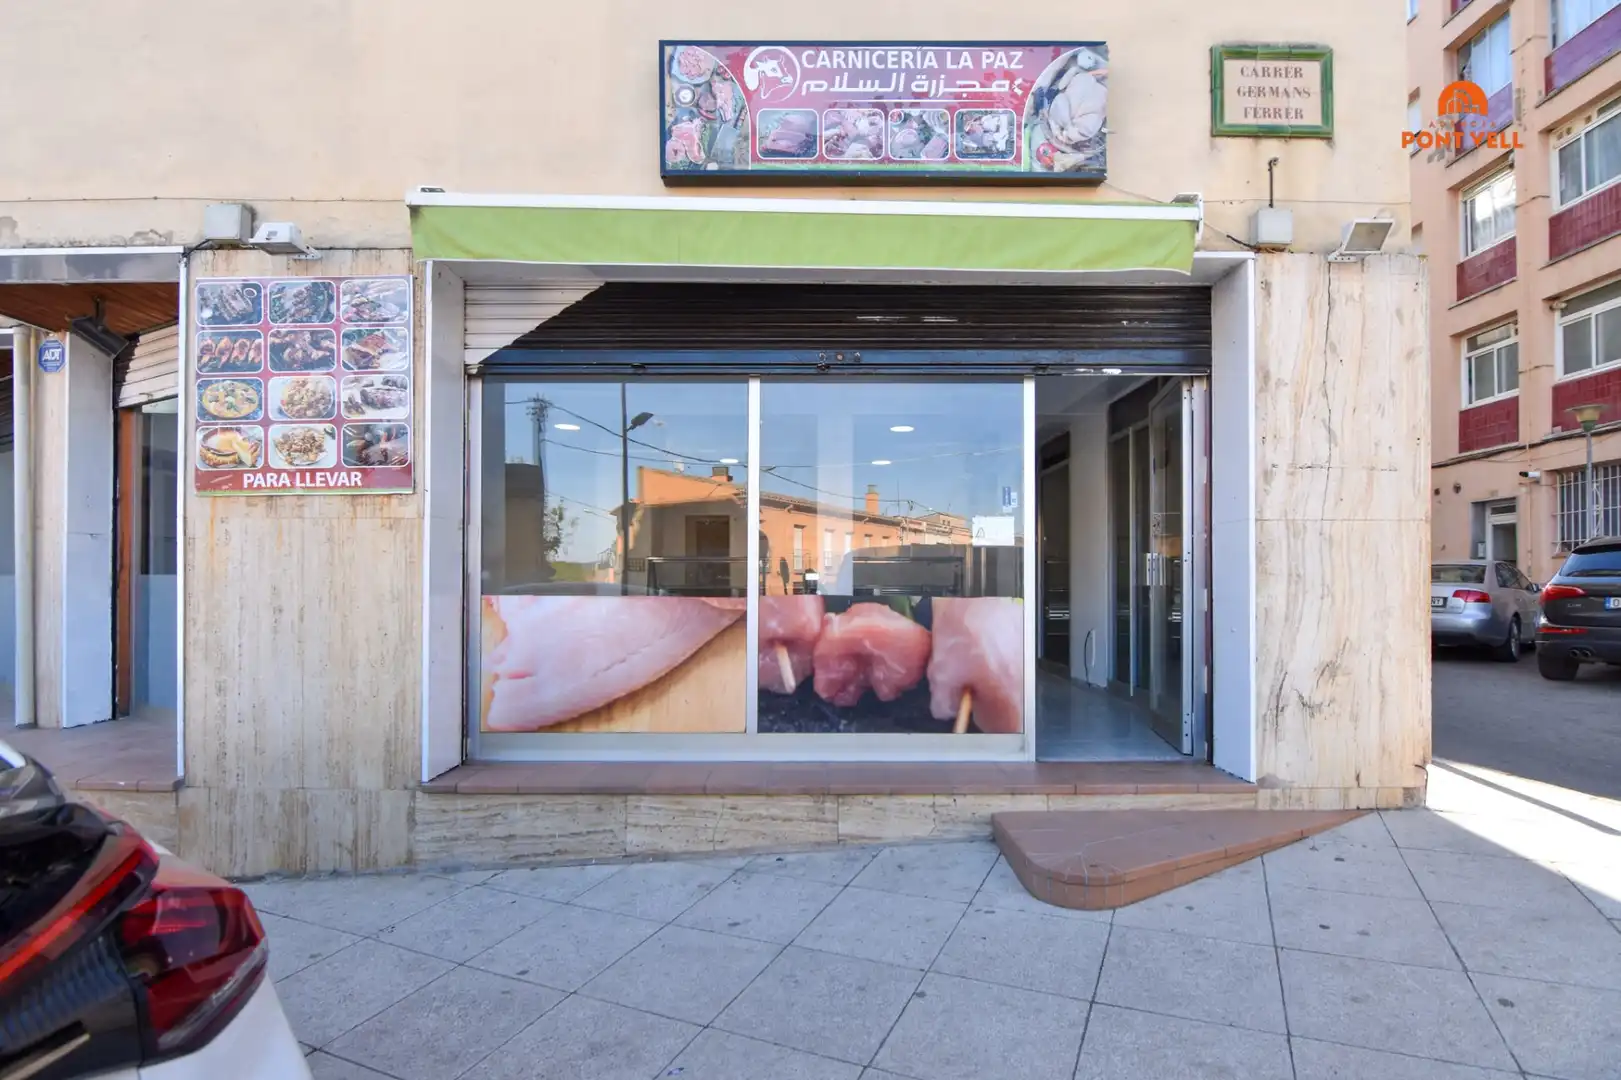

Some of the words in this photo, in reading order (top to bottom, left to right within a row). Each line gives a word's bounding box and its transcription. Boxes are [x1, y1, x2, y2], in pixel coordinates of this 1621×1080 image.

[946, 51, 973, 69] LA
[982, 51, 1024, 69] PAZ
[1240, 66, 1304, 79] CARRER
[801, 72, 906, 96] السلام
[910, 74, 1011, 98] مجزرة
[1236, 85, 1311, 99] GERMANS
[1243, 106, 1304, 120] FERRER
[43, 348, 62, 360] ADT
[243, 472, 291, 488] PARA
[295, 471, 362, 487] LLEVAR
